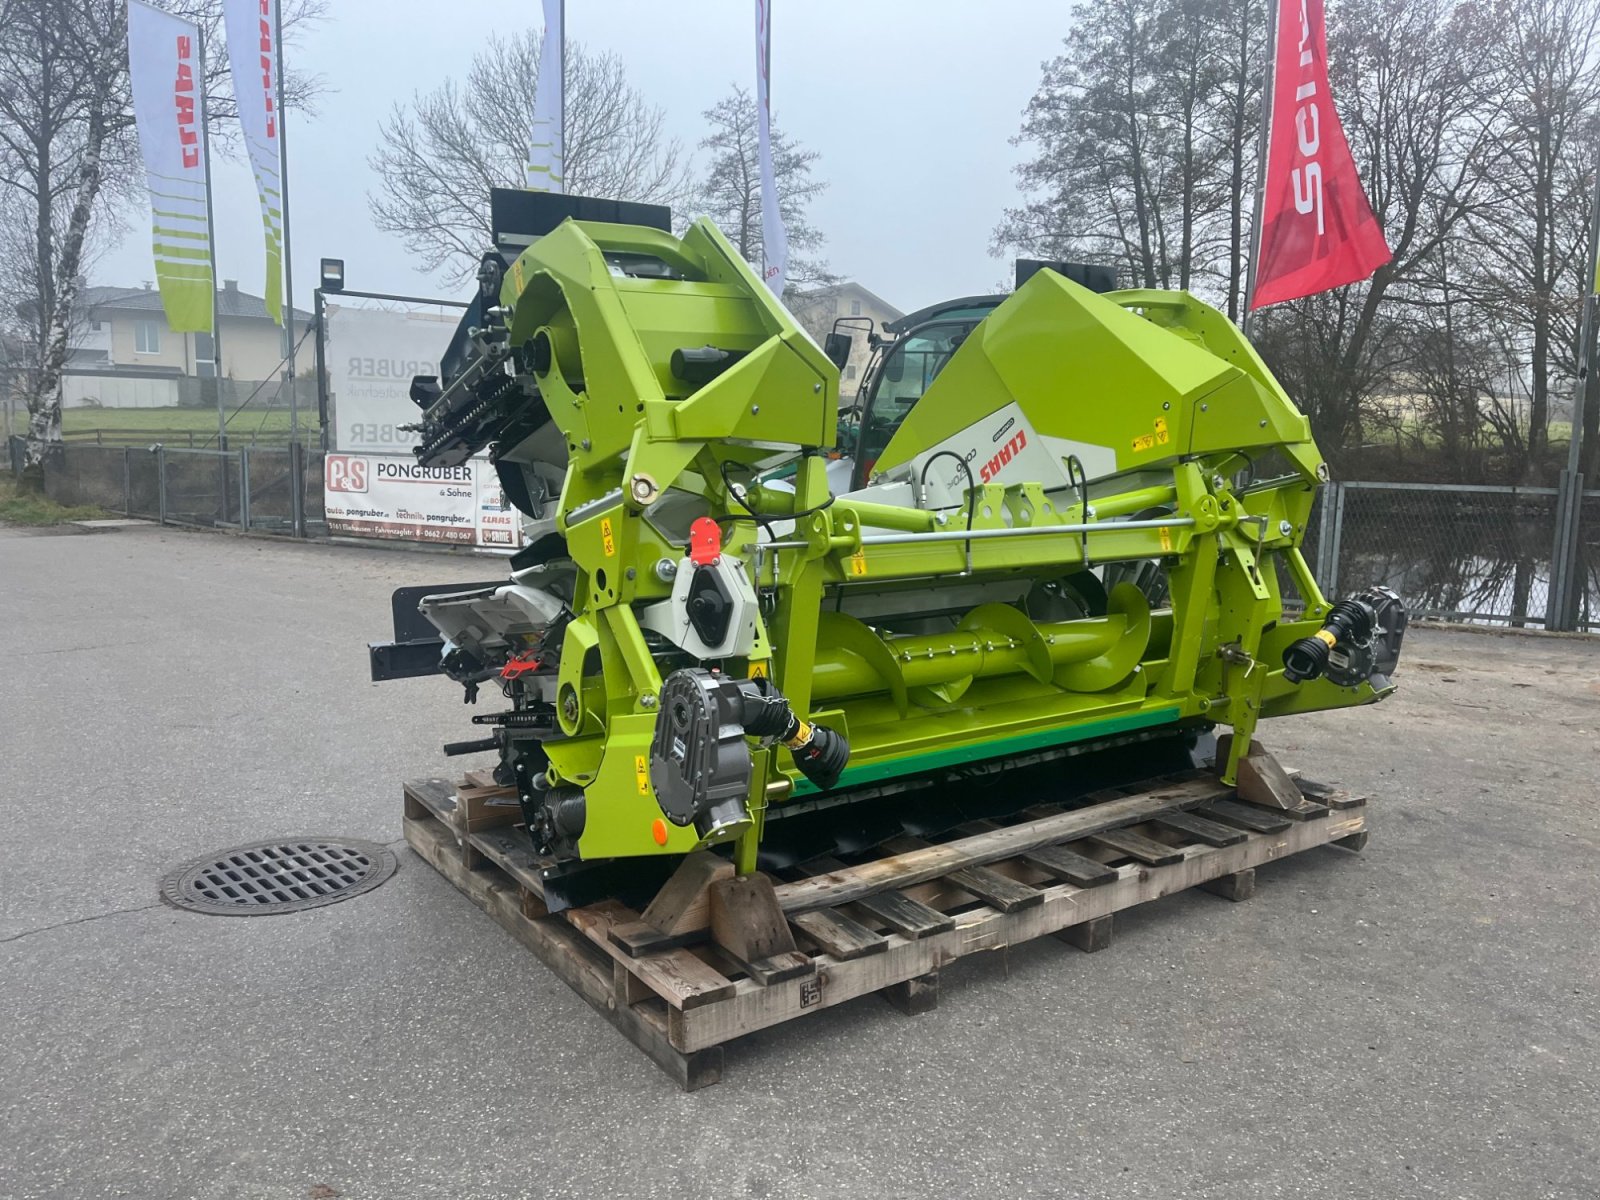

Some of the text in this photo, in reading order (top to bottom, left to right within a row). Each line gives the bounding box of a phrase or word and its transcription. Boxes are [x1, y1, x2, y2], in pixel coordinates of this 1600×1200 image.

[979, 429, 1027, 484] CLAAS
[329, 459, 367, 491] P&S
[377, 463, 472, 481] PONGRUBER
[446, 487, 472, 498] Söhne
[482, 516, 511, 524] CLAAS
